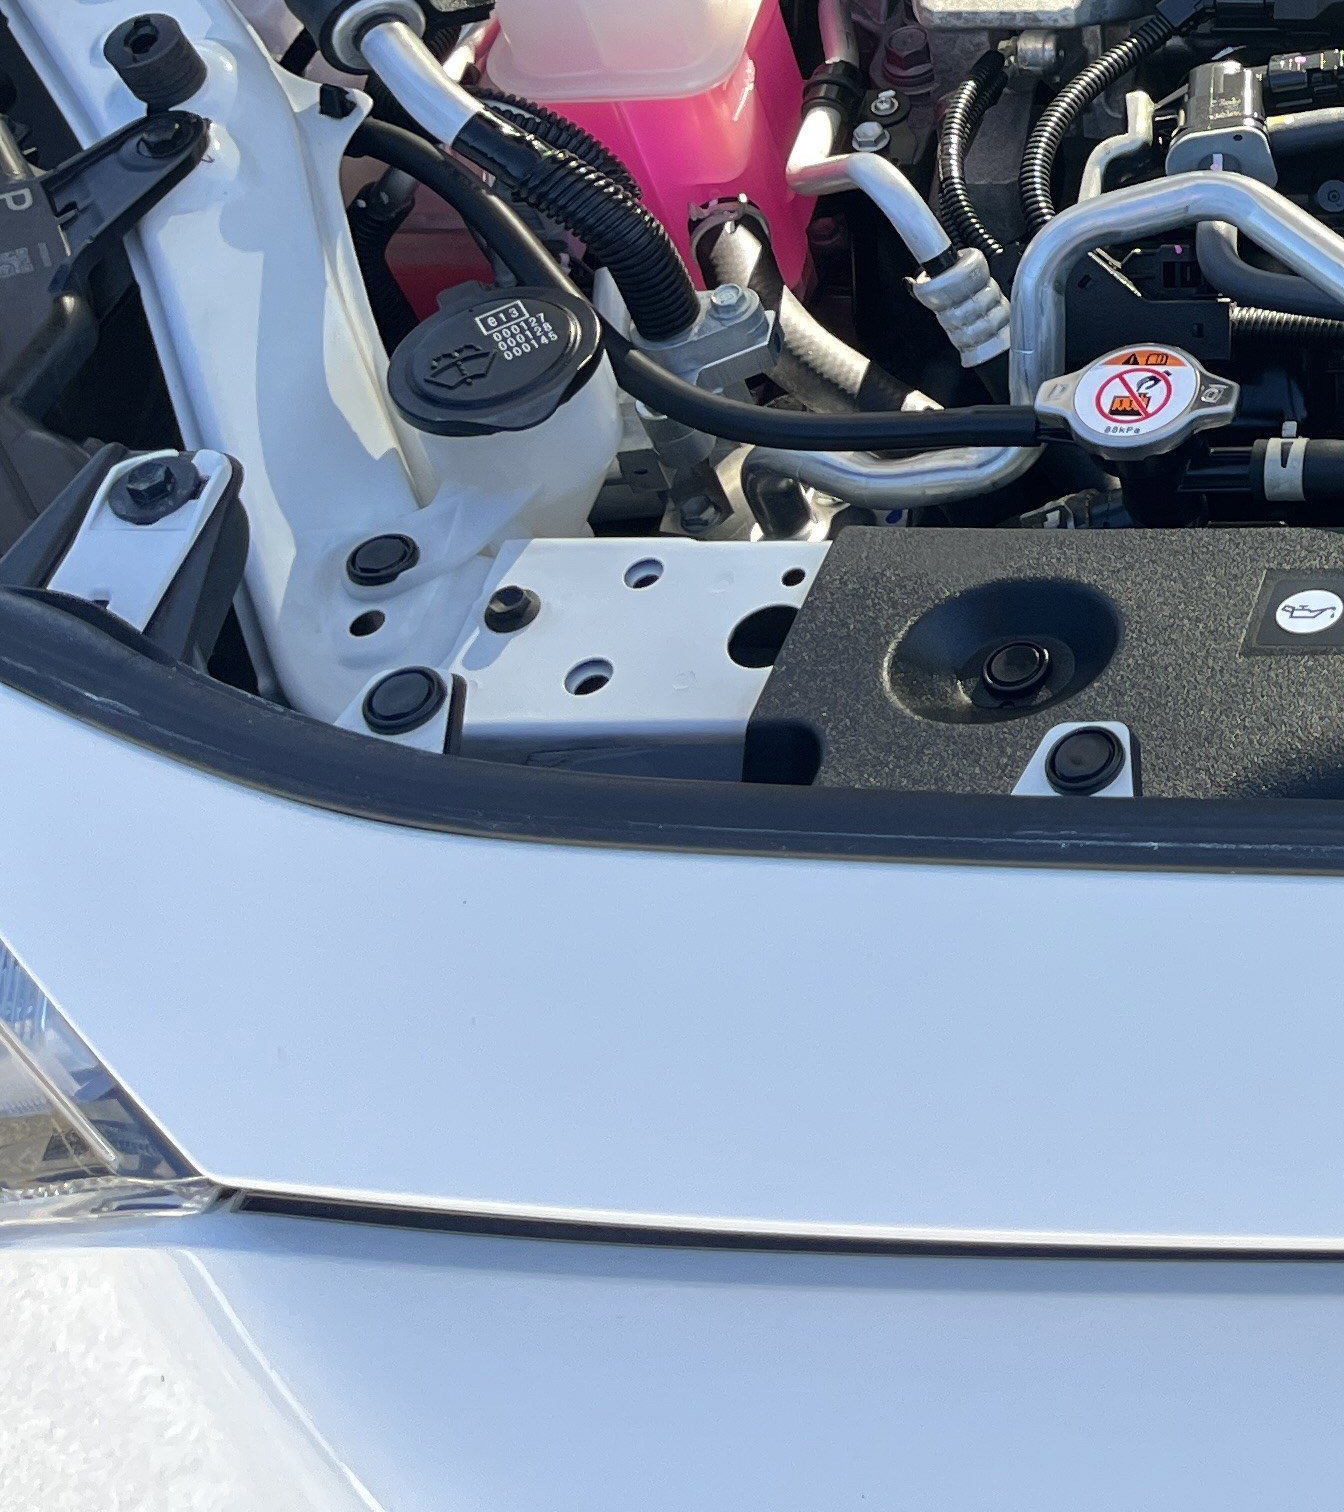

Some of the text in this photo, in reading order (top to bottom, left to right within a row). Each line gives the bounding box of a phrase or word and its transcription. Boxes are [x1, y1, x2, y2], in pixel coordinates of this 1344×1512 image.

[492, 313, 545, 342] 000127
[498, 322, 552, 351] 000128
[503, 331, 558, 361] 000145
